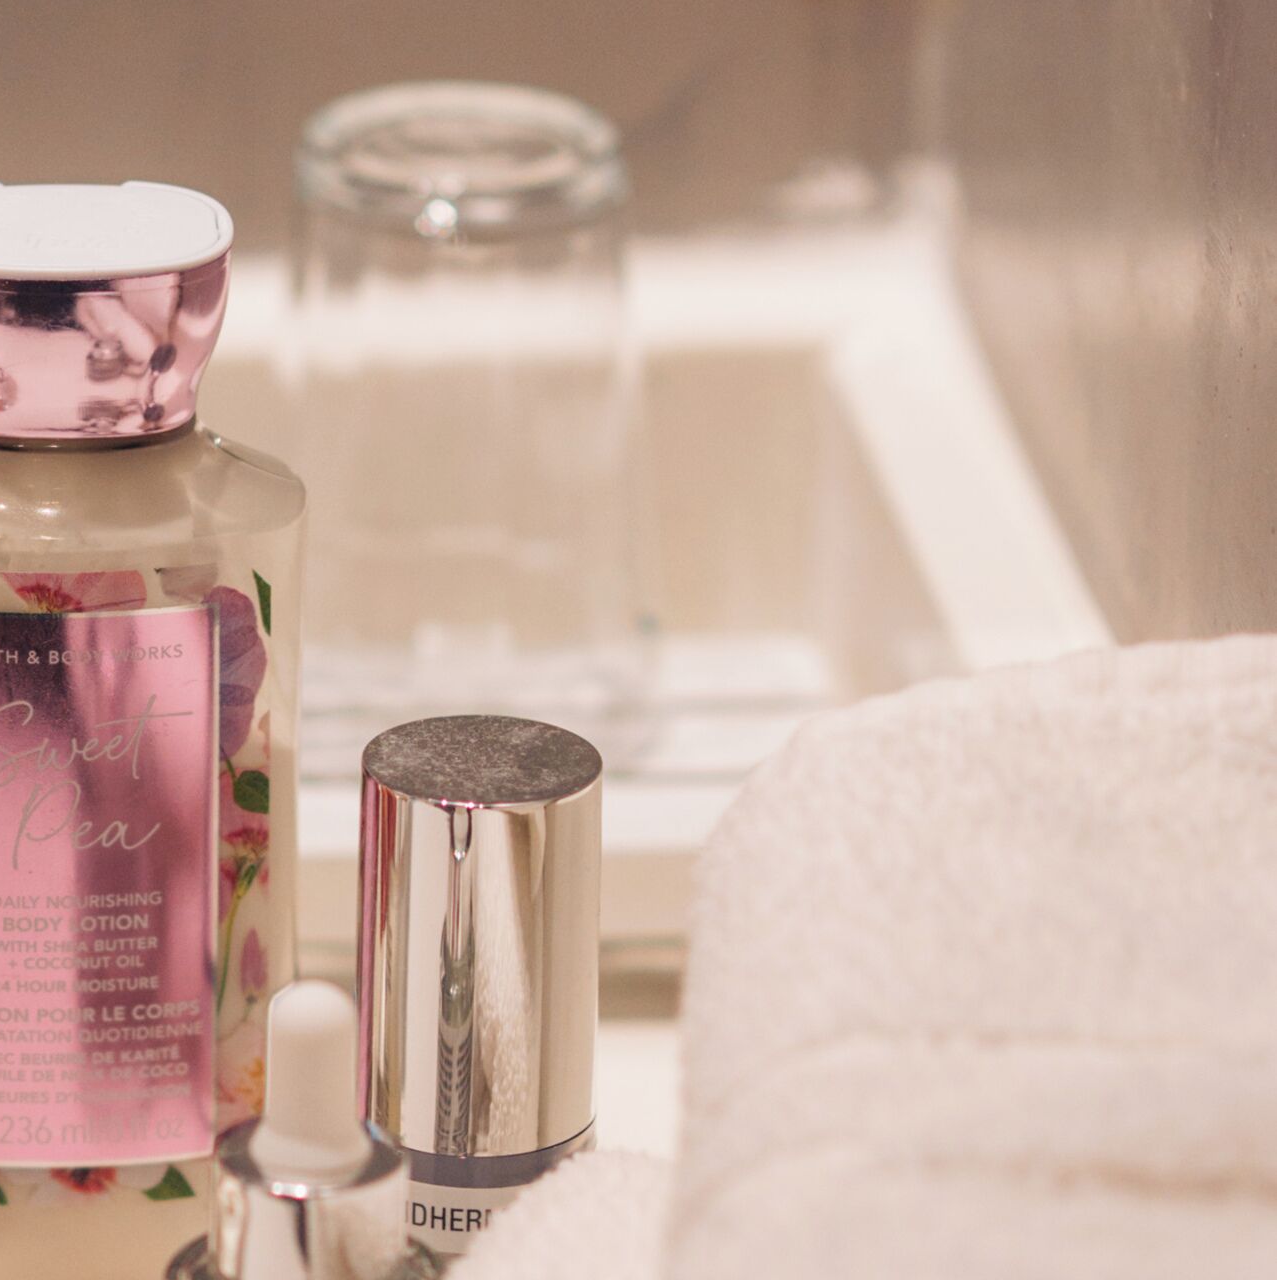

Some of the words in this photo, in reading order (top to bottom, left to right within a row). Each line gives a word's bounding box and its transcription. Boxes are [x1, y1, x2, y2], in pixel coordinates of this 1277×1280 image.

[26, 650, 41, 665] &
[48, 648, 104, 665] BODY
[111, 644, 184, 662] WORKS
[11, 779, 162, 870] Pea
[46, 890, 164, 910] NOURISHING
[2, 916, 63, 932] BODY
[70, 913, 150, 932] LOTION
[43, 939, 88, 953] SHEA
[94, 936, 159, 952] BUTTER
[23, 956, 110, 970] COCONUT
[116, 954, 145, 969] OIL
[16, 980, 67, 993] HOUR
[72, 975, 160, 993] MOISTURE
[36, 1006, 96, 1023] POUR
[101, 1005, 126, 1022] LE
[131, 999, 200, 1020] CORPS
[78, 1021, 203, 1043] QUOTIDIENNE
[91, 1051, 115, 1065] DE
[32, 1070, 55, 1083] DE
[139, 1062, 189, 1079] COCO
[0, 1115, 52, 1146] 236
[404, 1199, 494, 1234] IDHER
